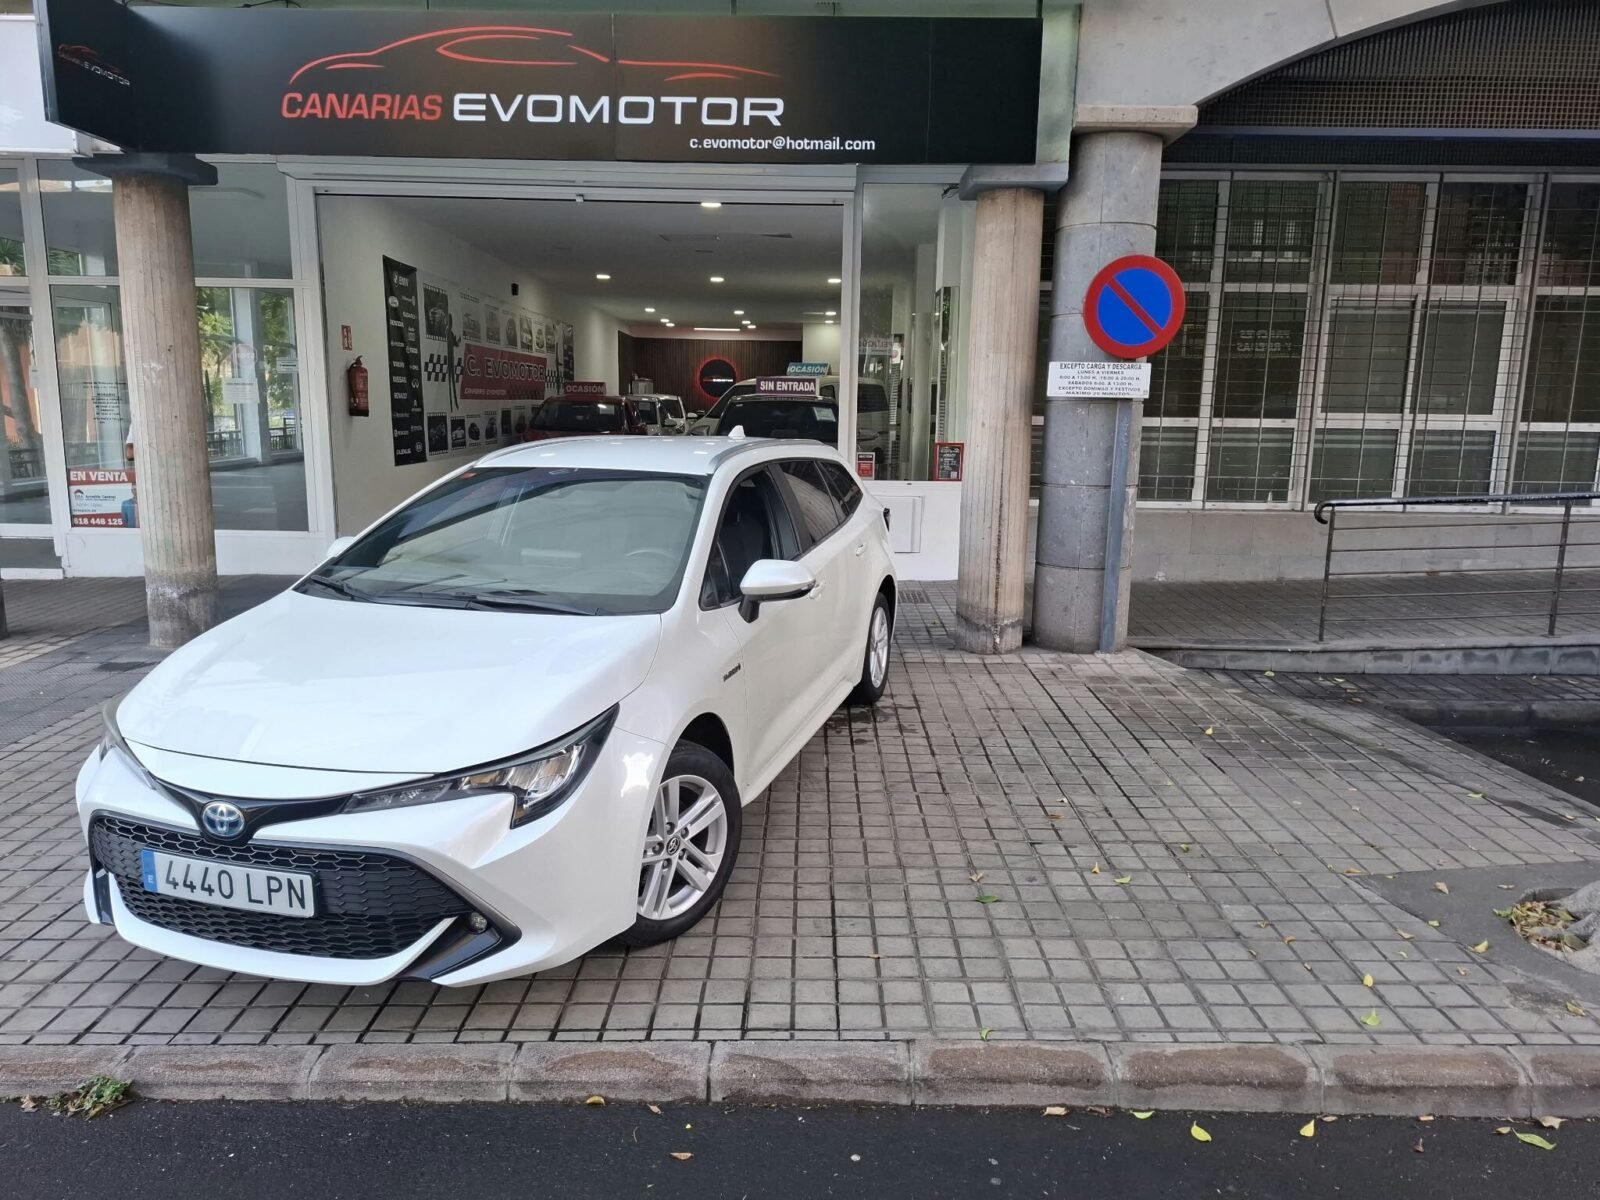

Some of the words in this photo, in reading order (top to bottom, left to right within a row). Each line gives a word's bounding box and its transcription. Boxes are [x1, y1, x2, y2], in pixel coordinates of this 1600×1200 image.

[281, 92, 443, 121] CANARIAS
[453, 93, 785, 126] EVOMOTOR
[689, 136, 876, 152] c.evomotor@hotmail.com
[466, 354, 481, 376] C.
[484, 357, 545, 382] EVOMOTOR
[760, 381, 775, 391] SIN
[776, 381, 815, 392] ENTRADA
[69, 471, 86, 481] EN
[89, 471, 128, 481] VENTA
[107, 518, 123, 526] 125
[147, 875, 154, 884] E
[165, 860, 234, 900] 4440
[246, 873, 306, 910] LPN
